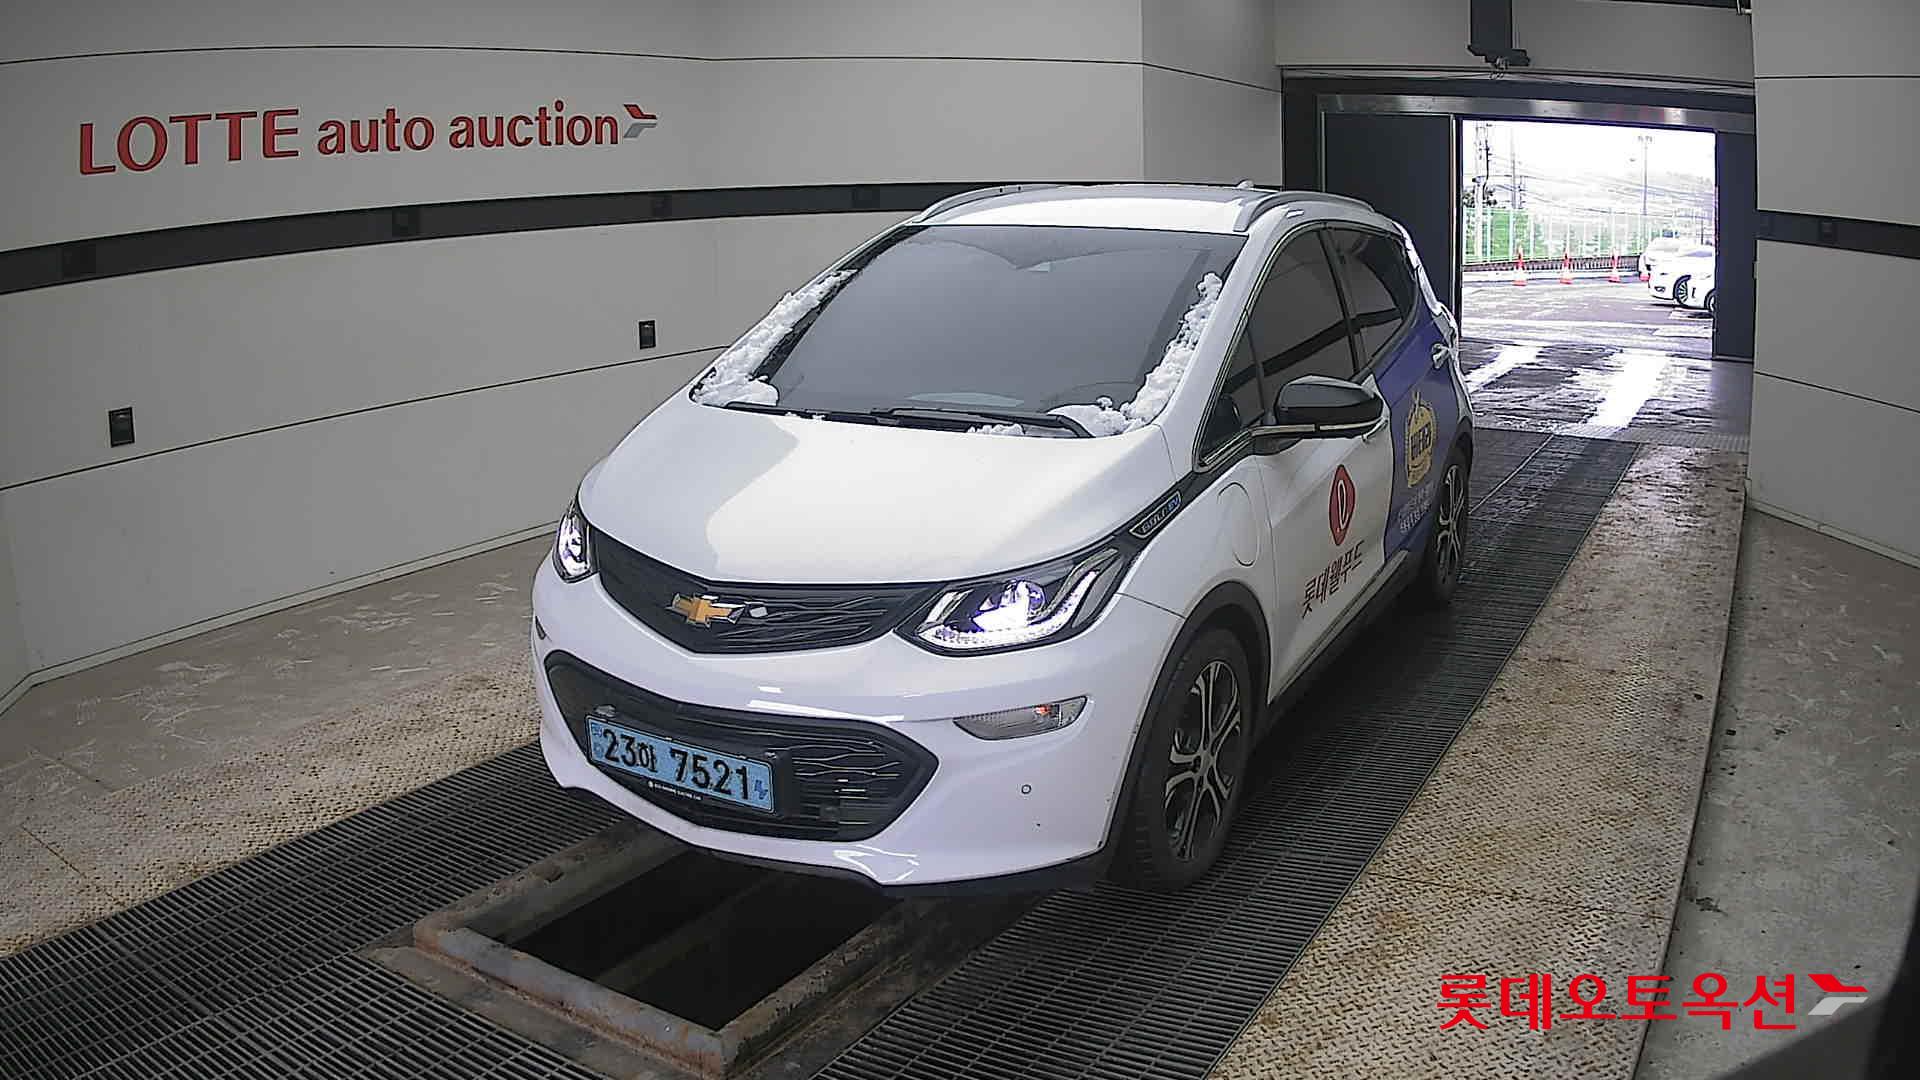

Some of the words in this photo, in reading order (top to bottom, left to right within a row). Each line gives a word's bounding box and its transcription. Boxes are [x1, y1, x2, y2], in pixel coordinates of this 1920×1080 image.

[79, 107, 300, 176] LOTTE
[317, 107, 435, 156] auto
[449, 100, 620, 149] auction
[1302, 540, 1365, 620] 롯데웰푸드
[669, 747, 749, 800] 7521
